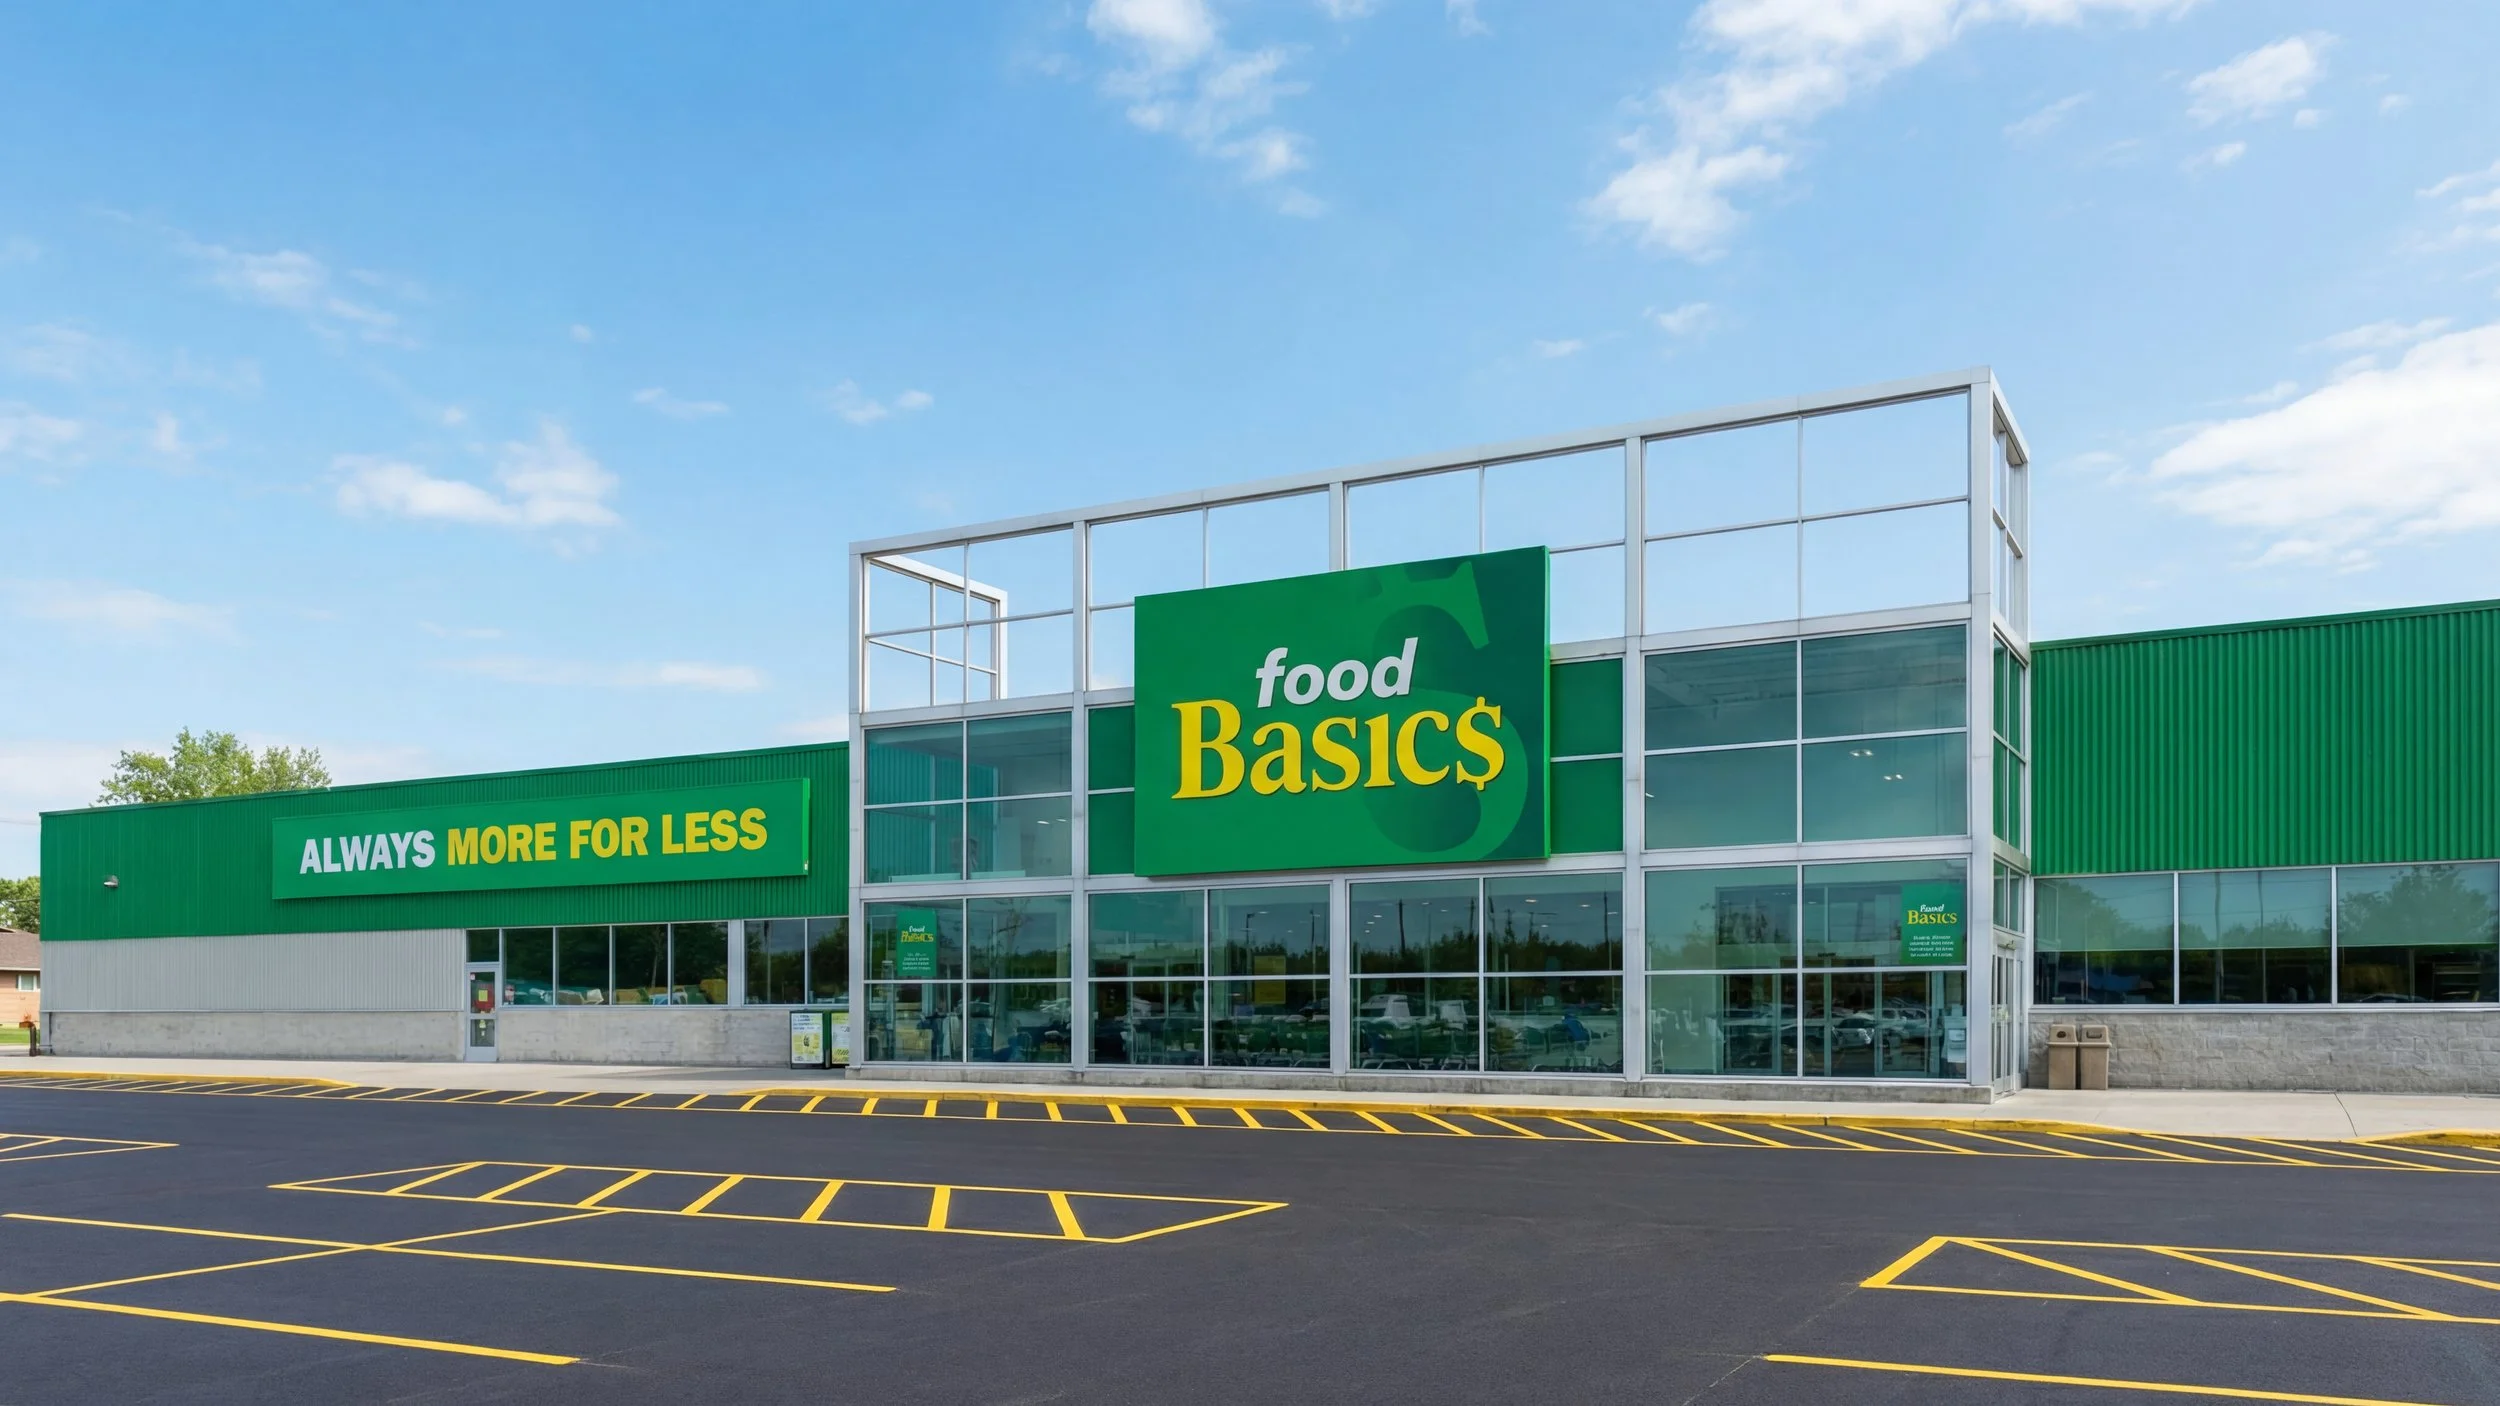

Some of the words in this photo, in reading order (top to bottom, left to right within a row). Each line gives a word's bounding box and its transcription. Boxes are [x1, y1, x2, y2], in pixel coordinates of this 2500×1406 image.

[1255, 636, 1418, 708] food
[299, 829, 436, 874] ALWAYS
[447, 822, 557, 866] MORE
[570, 816, 649, 859] FOR
[662, 807, 768, 855] LESS
